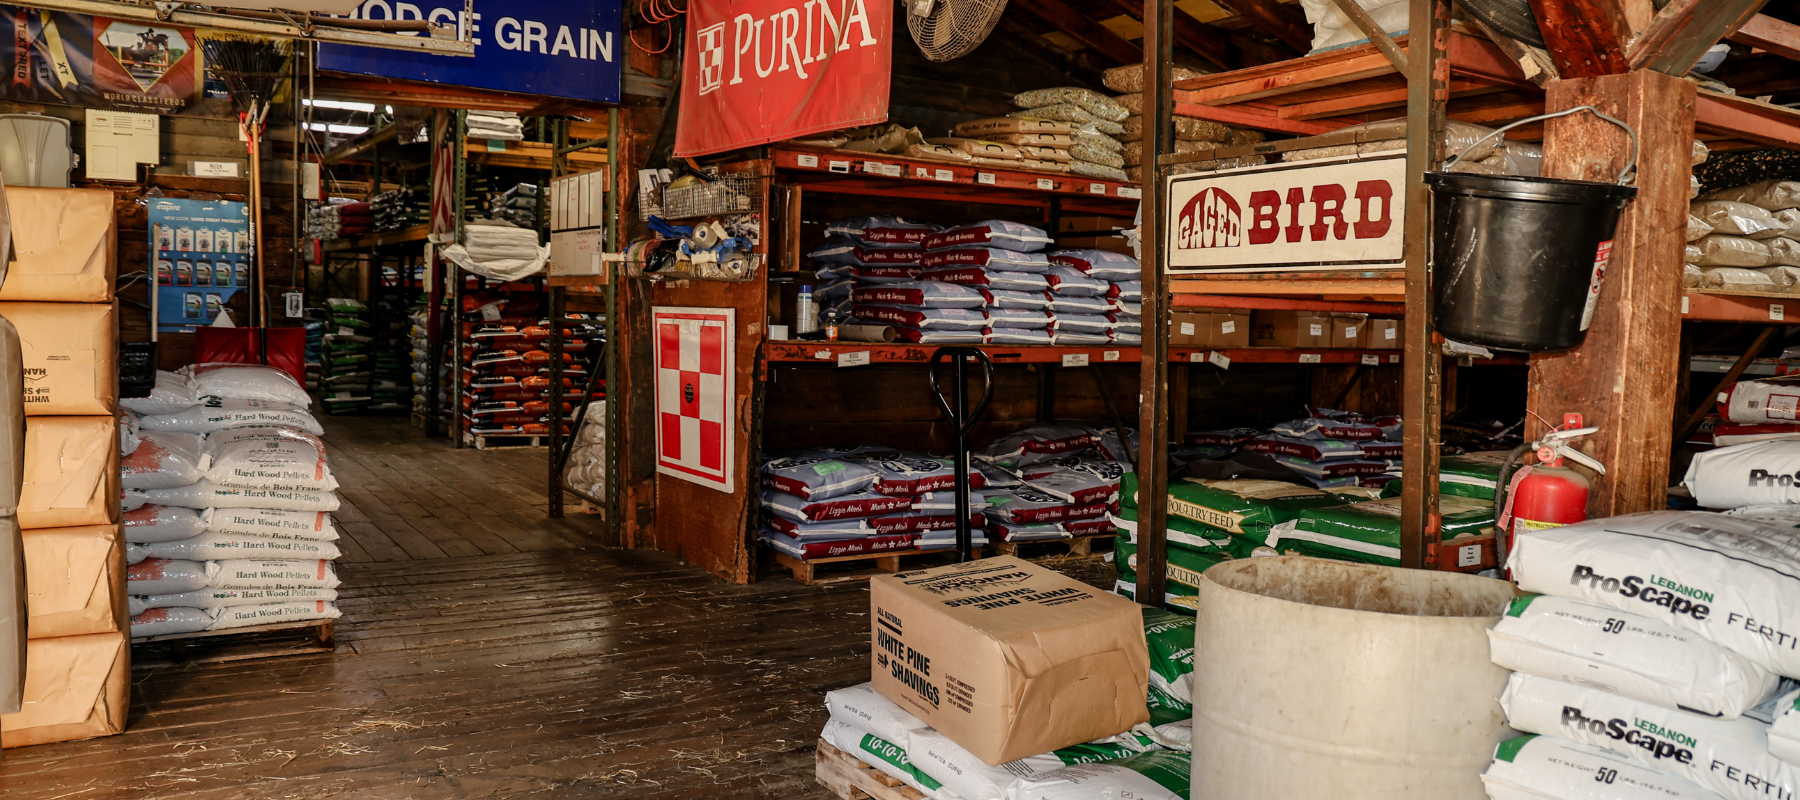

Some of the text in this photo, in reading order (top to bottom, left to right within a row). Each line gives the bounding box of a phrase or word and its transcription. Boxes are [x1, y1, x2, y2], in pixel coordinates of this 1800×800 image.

[494, 17, 612, 63] GRAIN
[729, 0, 877, 86] PURINA
[57, 61, 69, 76] XT
[103, 91, 133, 102] WORLD
[159, 96, 186, 107] FEEDS
[1247, 179, 1393, 245] BIRD
[258, 413, 280, 421] Wood
[281, 414, 306, 426] Pellets
[234, 469, 256, 477] Hard
[283, 471, 310, 479] Pellets
[220, 480, 258, 490] Granules
[273, 483, 293, 492] Bois
[295, 484, 322, 492] Franc
[244, 489, 321, 502] Hard Wood Pellets
[915, 482, 933, 492] Made
[828, 505, 846, 517] Lizzie
[846, 503, 863, 513] Mae's
[870, 501, 888, 511] Made
[1168, 499, 1234, 529] POULTRY FEED
[233, 516, 309, 530] Hard Wood Pellets
[876, 522, 893, 534] Lizzie
[915, 520, 933, 530] Made
[219, 528, 258, 537] Granules
[271, 532, 292, 540] Bois
[242, 541, 319, 552] Hard Wood Pellets
[828, 545, 847, 555] Lizzie
[846, 542, 863, 552] Mae's
[871, 541, 888, 550] Made
[235, 571, 312, 580] Hard Wood Pellets
[938, 571, 1029, 591] HANCOCK
[1166, 565, 1202, 586] OULTRY
[241, 589, 318, 599] Hard Wood Pellets
[944, 587, 1037, 608] SHAVINGS
[973, 587, 1081, 611] WHITE PINE
[1570, 564, 1711, 621] ProScape
[1650, 574, 1715, 603] LEBANON
[258, 610, 282, 619] Wood
[284, 607, 311, 615] Pellets
[877, 606, 903, 628] ALL NATURAL
[1572, 614, 1603, 624] WEIGHT
[1602, 617, 1626, 635] 50
[1727, 612, 1798, 651] FERTI
[877, 627, 931, 677] WHITE PINE
[891, 659, 940, 706] SHAVINGS
[1561, 704, 1693, 766] ProScape
[1634, 717, 1697, 749] LEBANON
[1564, 761, 1595, 773] WEIGHT
[1594, 766, 1618, 785] 50
[1711, 759, 1791, 800] FERTI
